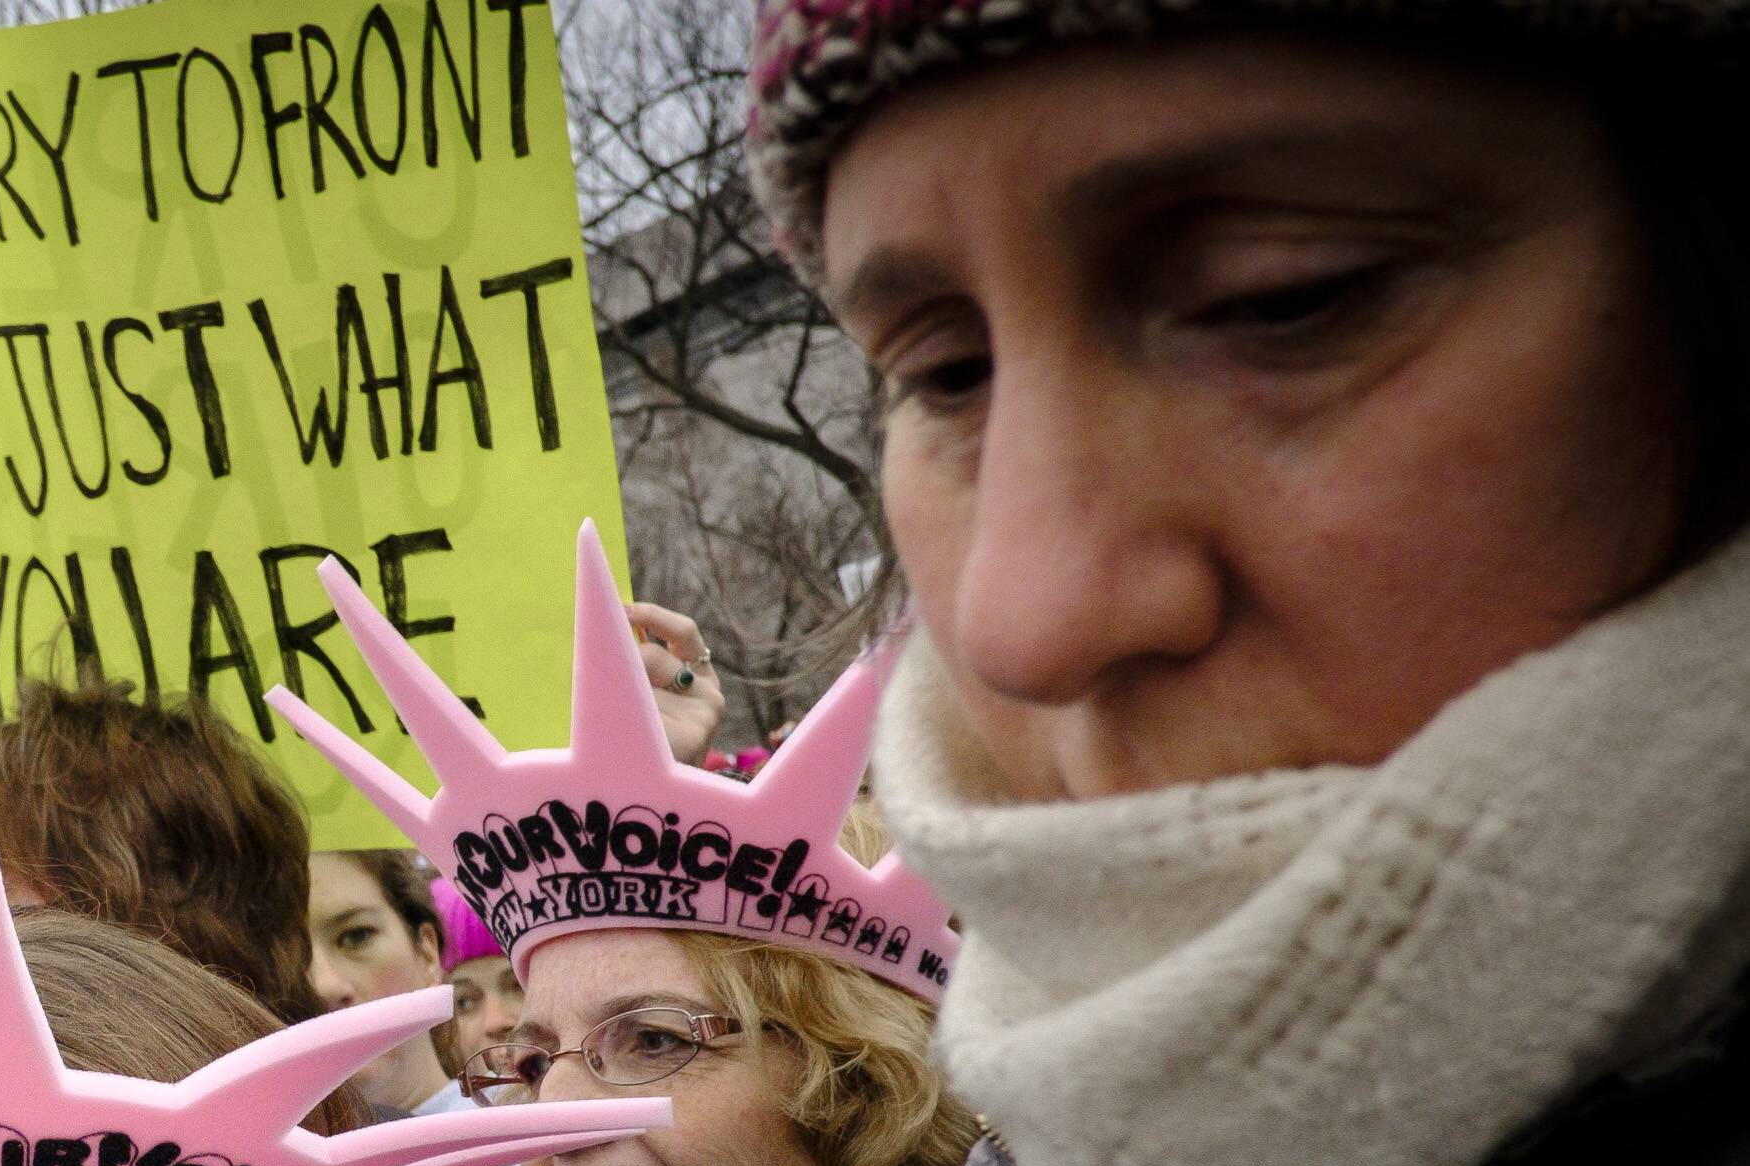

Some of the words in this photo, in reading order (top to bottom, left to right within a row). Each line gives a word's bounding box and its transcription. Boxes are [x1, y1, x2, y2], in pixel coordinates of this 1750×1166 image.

[96, 47, 245, 222] TO
[249, 0, 547, 200] FRONT
[248, 258, 574, 468] WHAT
[186, 527, 488, 743] ARE
[537, 871, 701, 921] YORK
